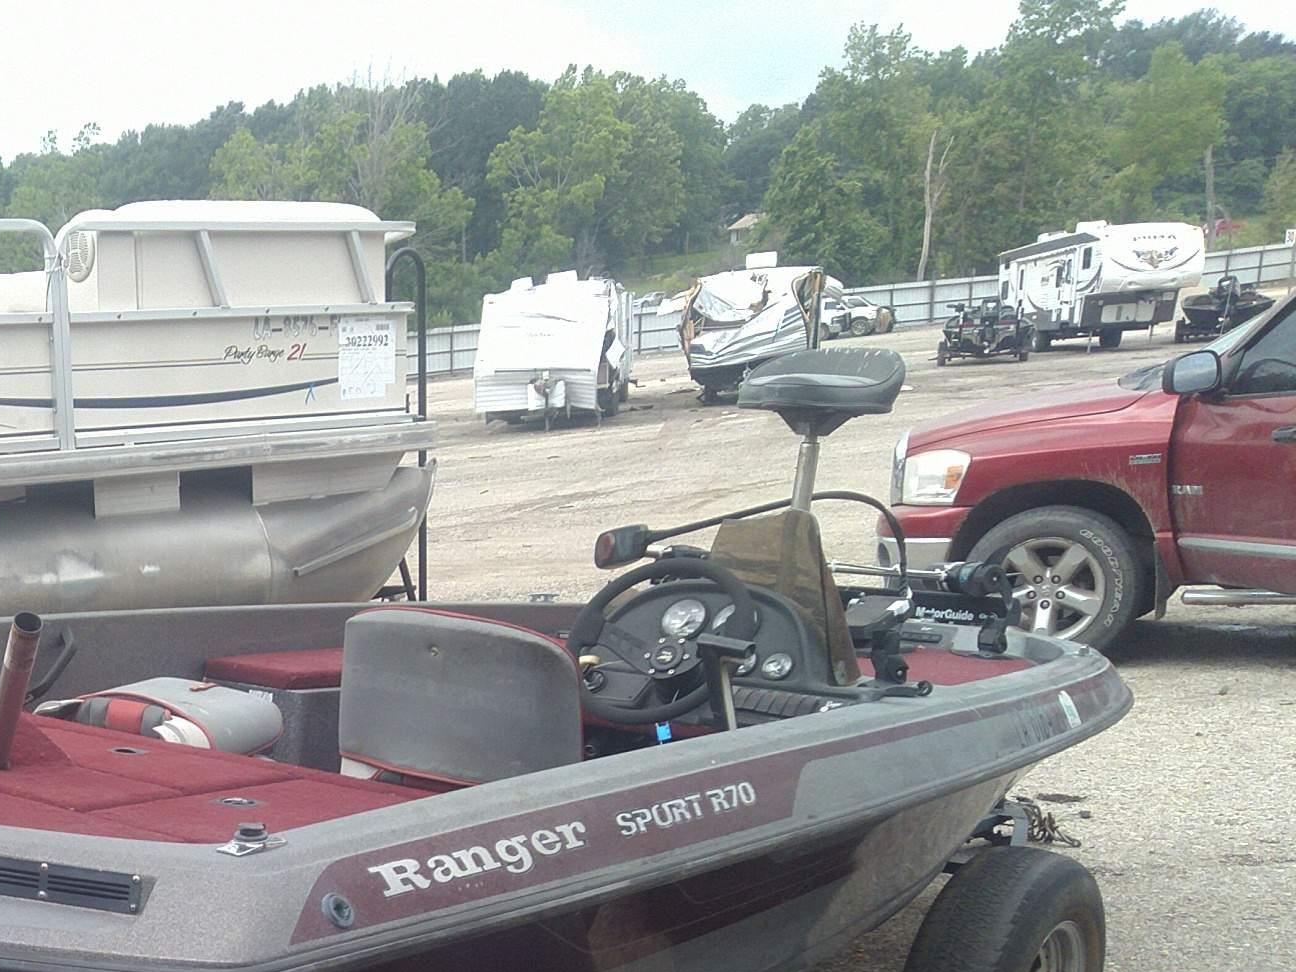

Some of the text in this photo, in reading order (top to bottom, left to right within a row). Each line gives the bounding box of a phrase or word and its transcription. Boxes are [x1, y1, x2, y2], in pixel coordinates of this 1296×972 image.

[345, 334, 390, 348] 30222992
[224, 343, 307, 365] Party Barge 21
[1172, 485, 1203, 496] RAM
[1079, 529, 1124, 628] GOODYEAR
[368, 781, 757, 898] Ranger SPORT R70
